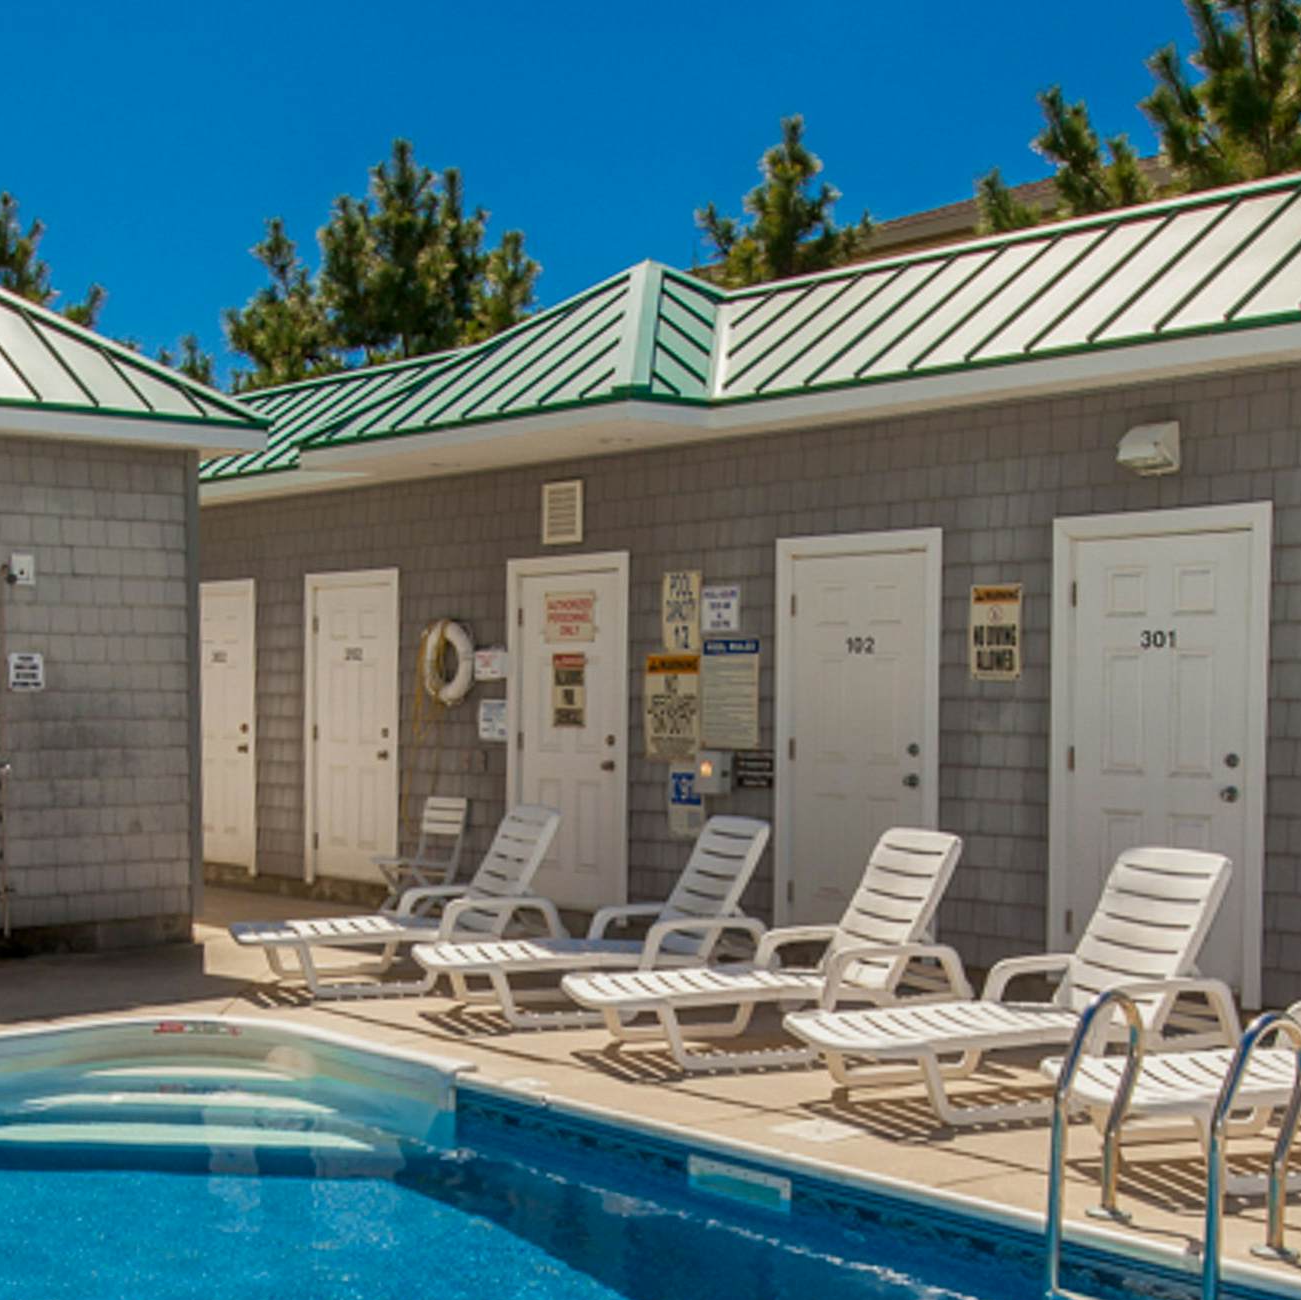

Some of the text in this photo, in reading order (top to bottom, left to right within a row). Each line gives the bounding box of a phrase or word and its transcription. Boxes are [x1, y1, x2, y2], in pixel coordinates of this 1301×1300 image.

[846, 636, 875, 655] 102
[974, 625, 985, 647] NO
[1141, 629, 1177, 650] 301
